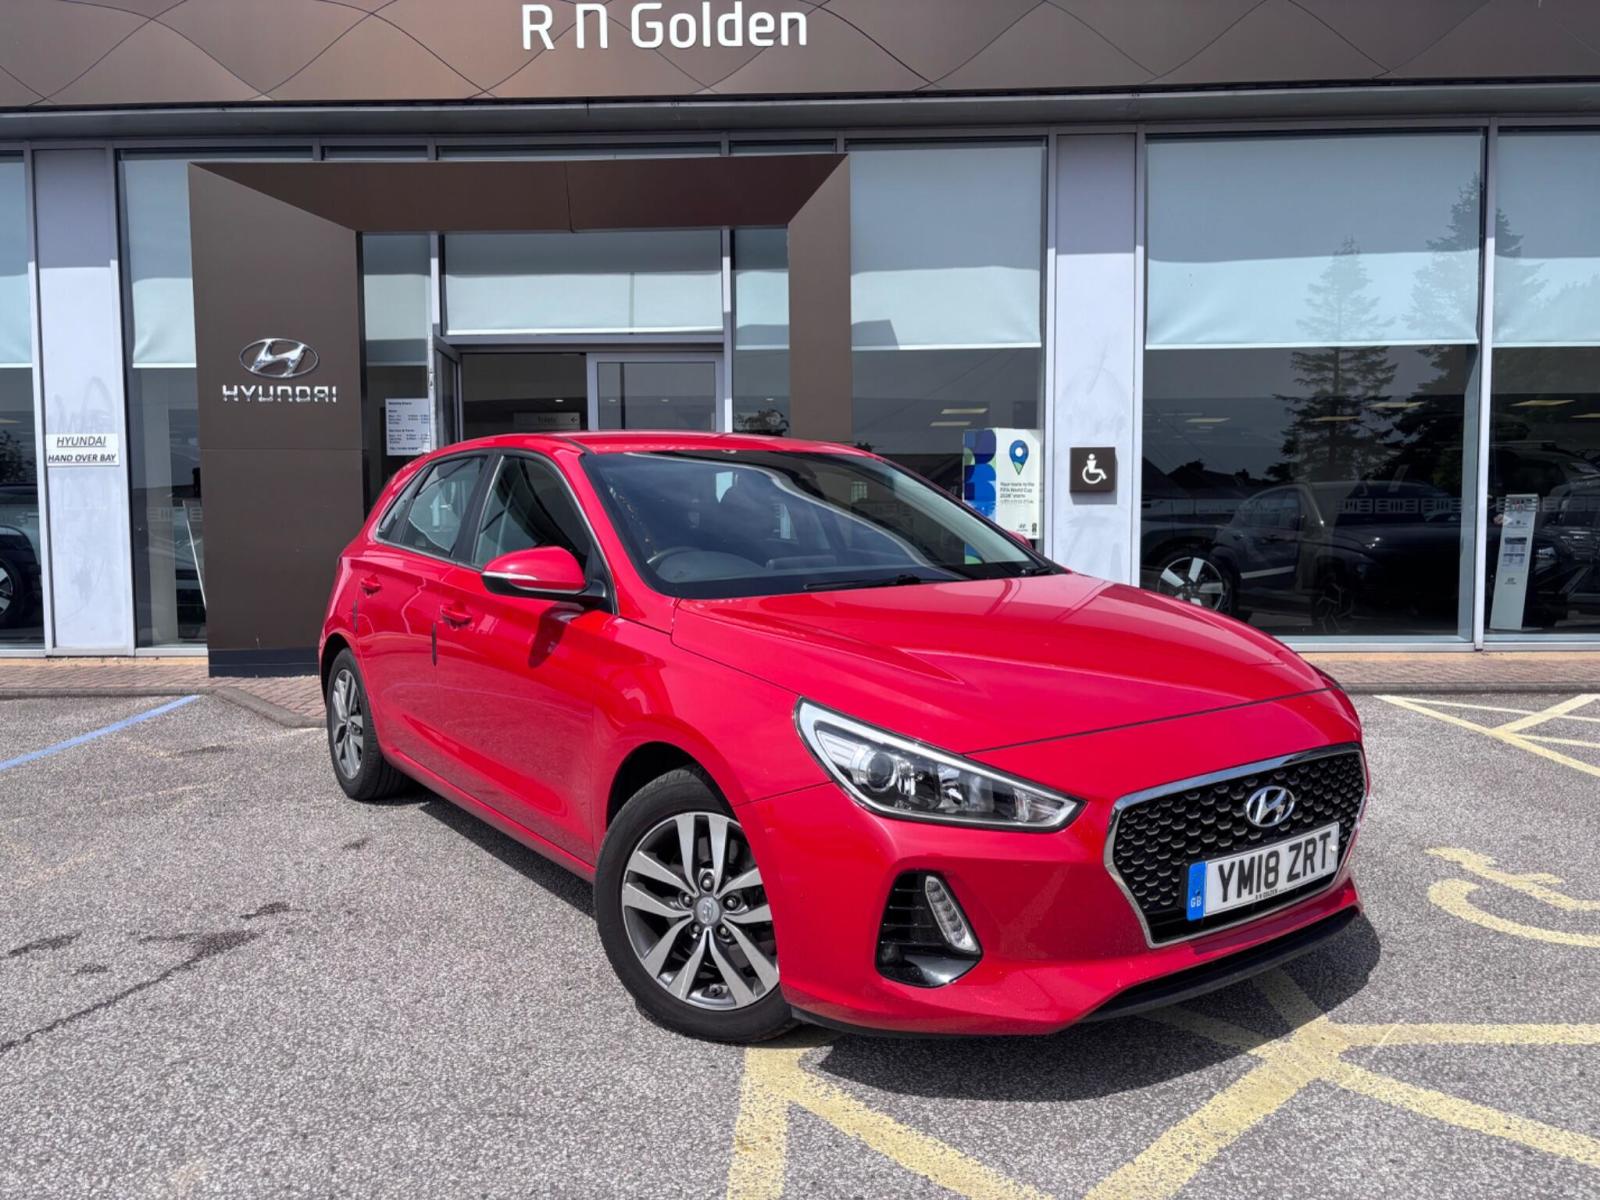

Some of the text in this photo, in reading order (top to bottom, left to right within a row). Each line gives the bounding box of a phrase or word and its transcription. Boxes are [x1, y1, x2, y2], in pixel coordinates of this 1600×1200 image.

[522, 4, 556, 50] R
[631, 1, 807, 49] Golden
[222, 384, 337, 403] HYUNDAI
[56, 436, 107, 448] HYUNDAI
[48, 453, 117, 462] HAND OVER BAY
[1218, 831, 1331, 902] YM18 ZRT
[1190, 896, 1202, 908] GB
